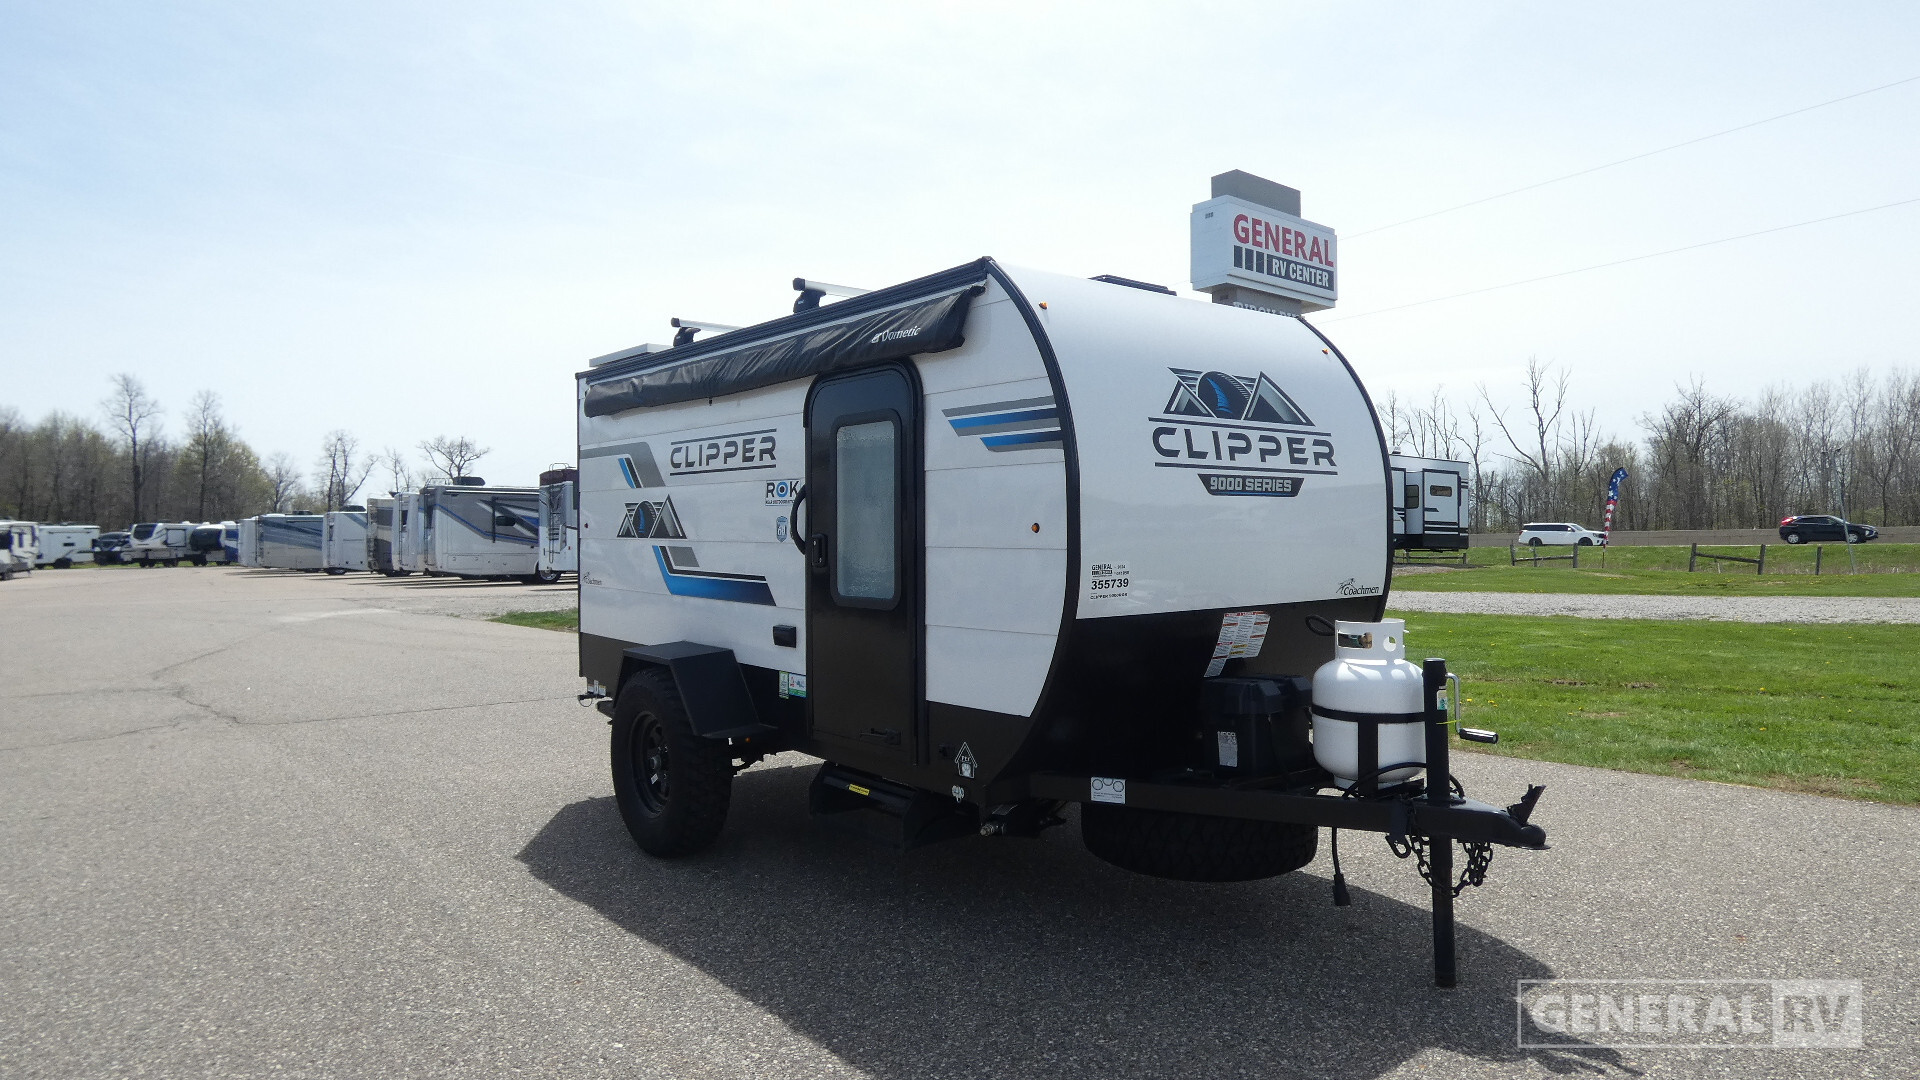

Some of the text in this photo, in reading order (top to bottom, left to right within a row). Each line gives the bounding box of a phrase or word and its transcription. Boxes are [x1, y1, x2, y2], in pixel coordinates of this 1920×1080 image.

[1234, 214, 1334, 267] GENERAL
[1272, 258, 1329, 288] RV CENTER
[881, 325, 921, 342] Dometic
[670, 435, 777, 469] CLIPPER
[1152, 426, 1337, 467] CLIPPER
[766, 480, 800, 498] ROK
[1210, 477, 1292, 493] 9000 SERIES
[1091, 578, 1128, 590] 355739
[1343, 584, 1380, 596] Coachmen
